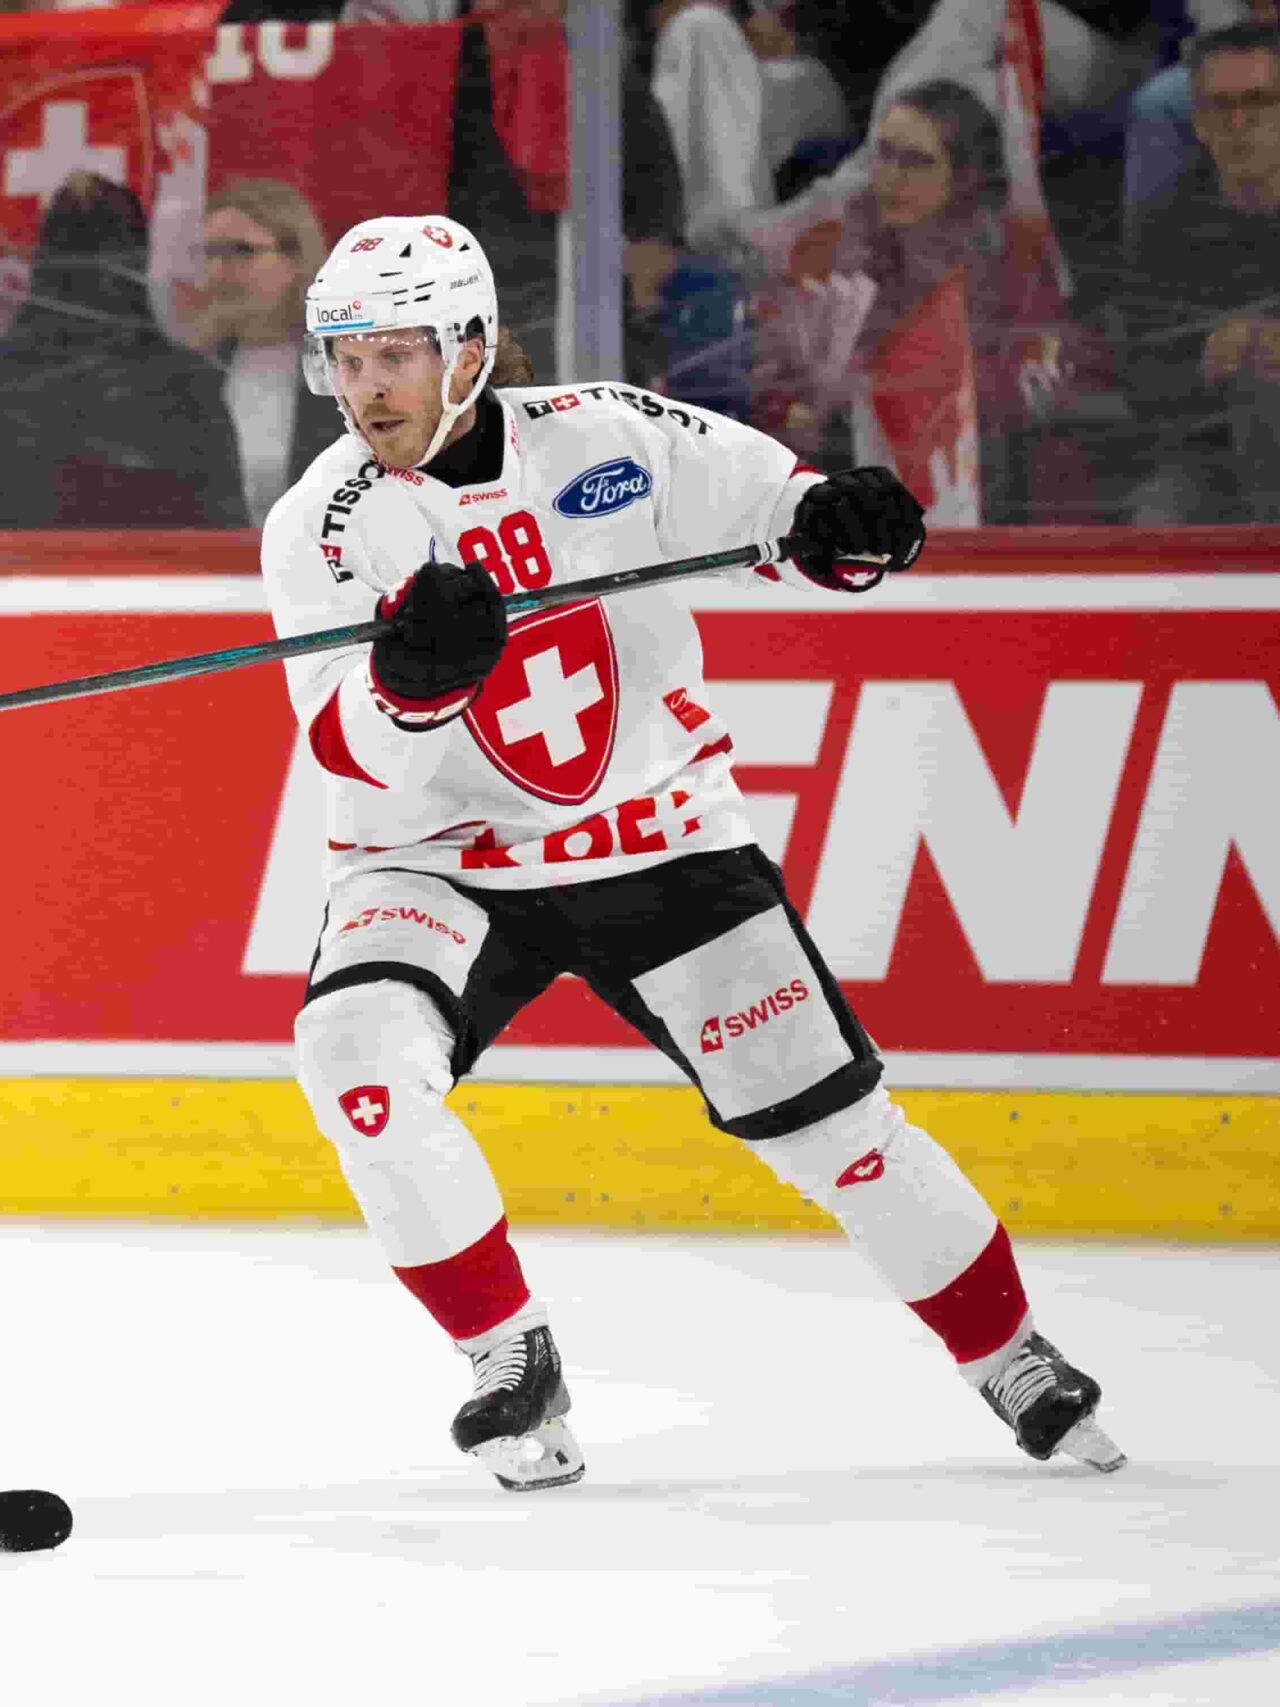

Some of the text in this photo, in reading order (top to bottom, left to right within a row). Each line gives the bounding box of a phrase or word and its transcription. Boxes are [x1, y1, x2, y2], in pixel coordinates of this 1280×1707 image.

[350, 237, 384, 253] 88
[316, 304, 353, 324] local
[580, 386, 714, 436] TISSOT
[321, 460, 387, 539] TISSO
[472, 487, 508, 504] SWISS
[580, 466, 647, 511] Ford
[457, 509, 552, 596] 88
[380, 906, 467, 945] SWISS
[724, 978, 809, 1038] SWISS
